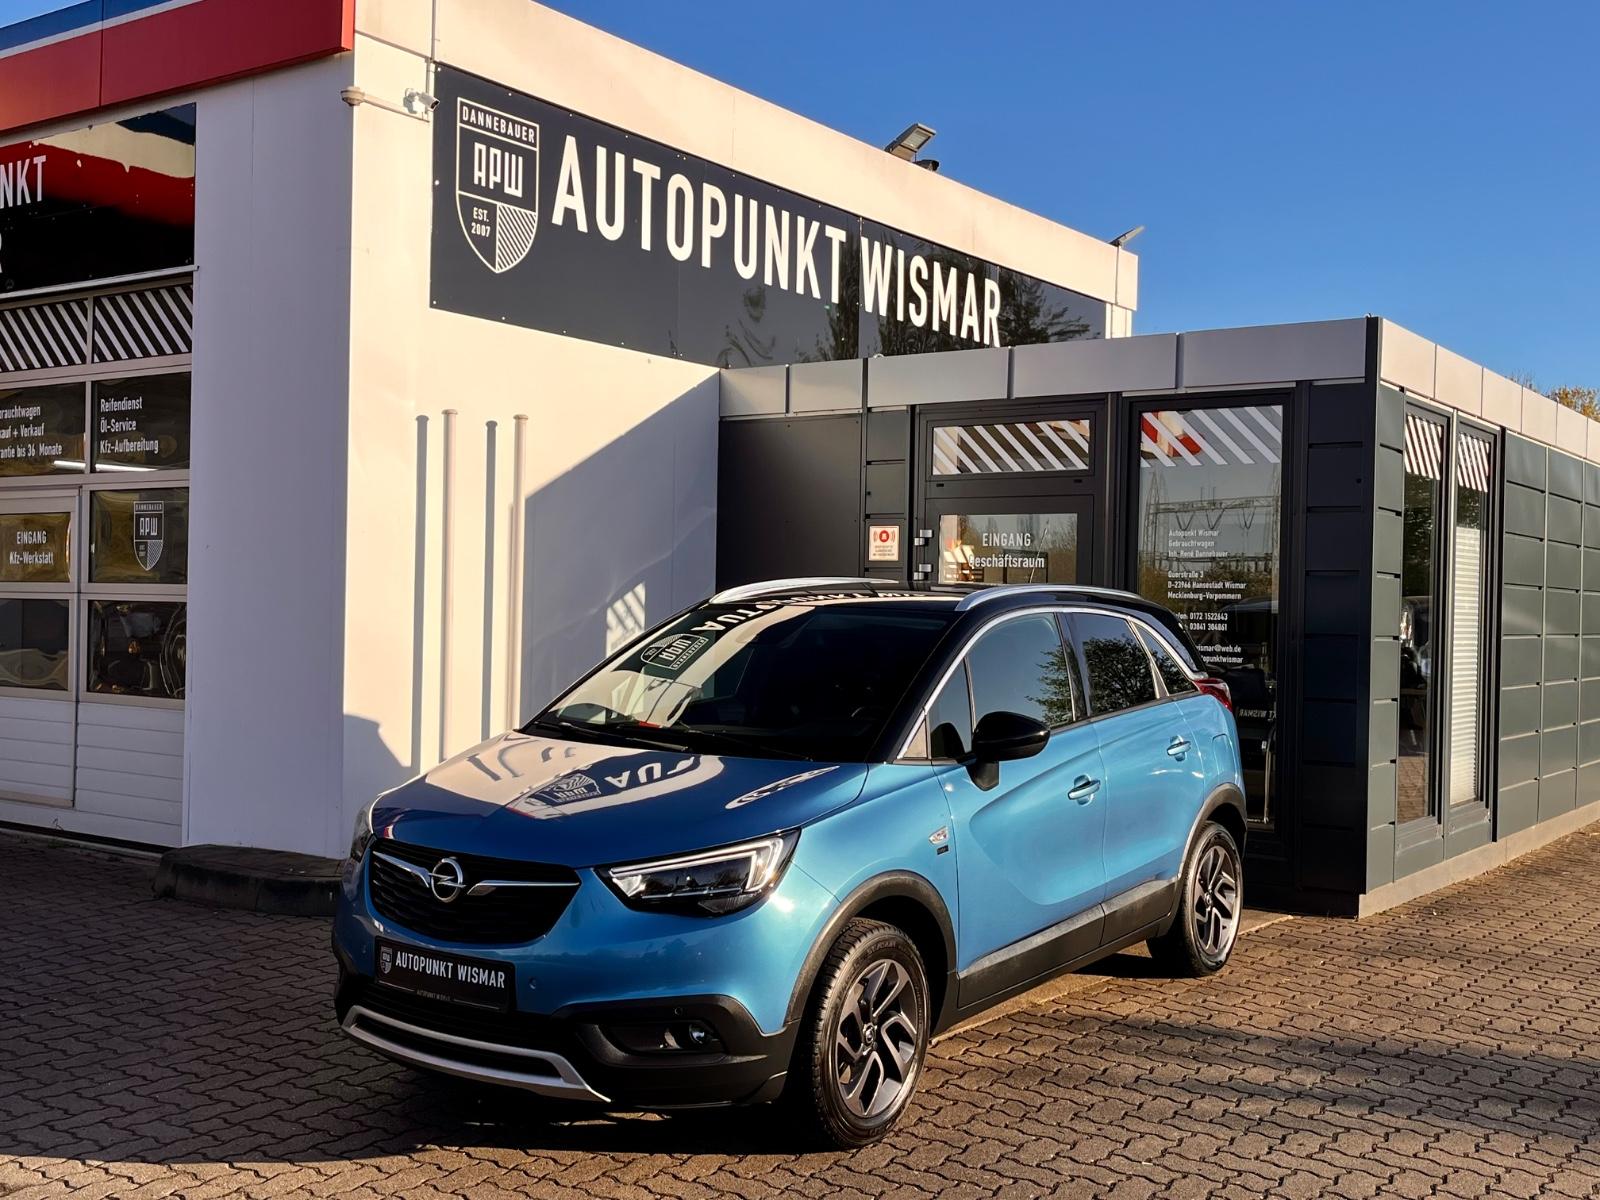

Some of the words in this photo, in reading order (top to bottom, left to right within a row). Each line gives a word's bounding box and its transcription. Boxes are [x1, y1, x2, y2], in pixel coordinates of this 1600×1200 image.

[462, 105, 535, 144] DANNEBAUER
[473, 141, 523, 198] APW
[472, 206, 490, 222] EST.
[471, 222, 491, 238] 2007
[551, 134, 847, 304] AUTOPUNKT
[860, 235, 1001, 348] WISMAR
[100, 396, 143, 412] Reifendienst
[0, 405, 41, 420] rauchtwagen
[20, 422, 45, 437] Verkauf
[100, 417, 137, 433] Öl-Service
[17, 445, 26, 457] bis
[28, 444, 36, 457] 36
[39, 443, 63, 456] Monate
[100, 437, 159, 454] Kfz-Aufbereitung
[139, 517, 158, 536] APW
[16, 531, 47, 545] EINGANG
[982, 532, 1032, 548] EINGANG
[10, 551, 54, 565] Kfz-Werkstatt
[968, 552, 1046, 569] Geschäftsraum
[1224, 581, 1247, 590] Wismar
[1189, 612, 1203, 621] 0172
[395, 950, 454, 979] AUTOPUNKT
[457, 963, 505, 989] WISMAR
